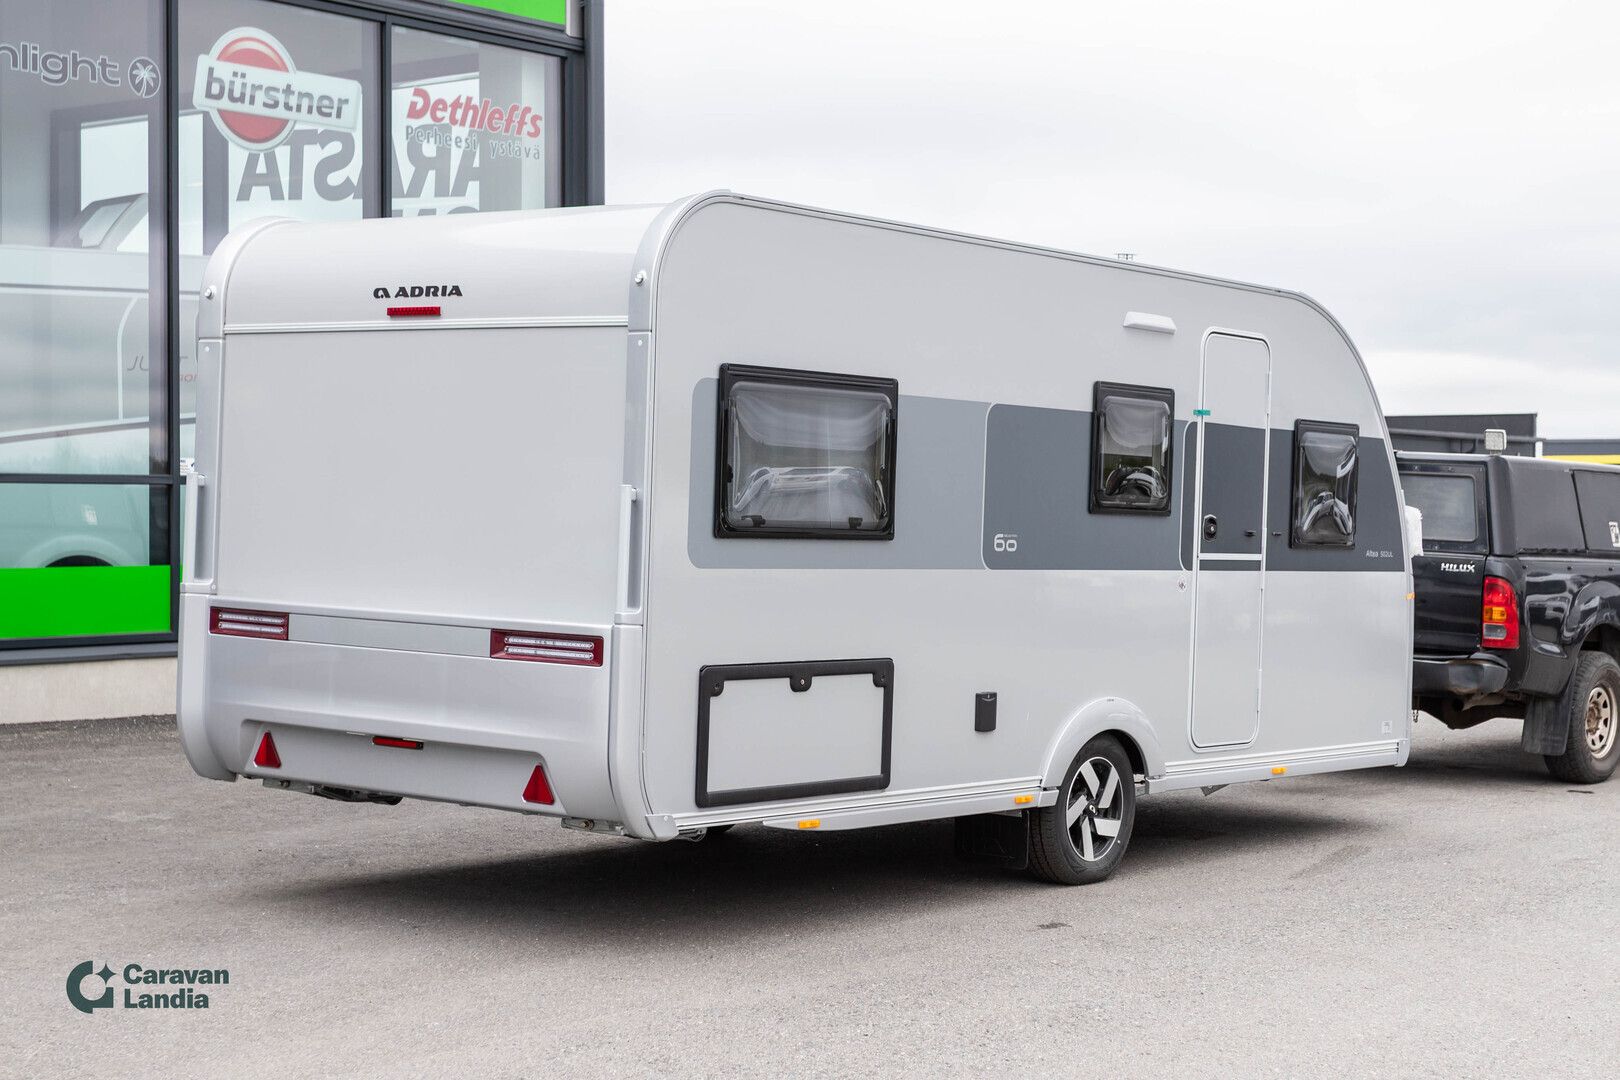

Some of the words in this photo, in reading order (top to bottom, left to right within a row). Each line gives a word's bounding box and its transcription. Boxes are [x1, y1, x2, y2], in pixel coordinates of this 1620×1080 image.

[205, 66, 350, 121] bürstner
[406, 87, 543, 139] Dethleffs
[405, 124, 478, 151] Perheesi
[490, 141, 541, 161] ystävä
[394, 284, 463, 299] ADRIA
[994, 533, 1018, 552] 60
[1440, 562, 1475, 573] HILUX
